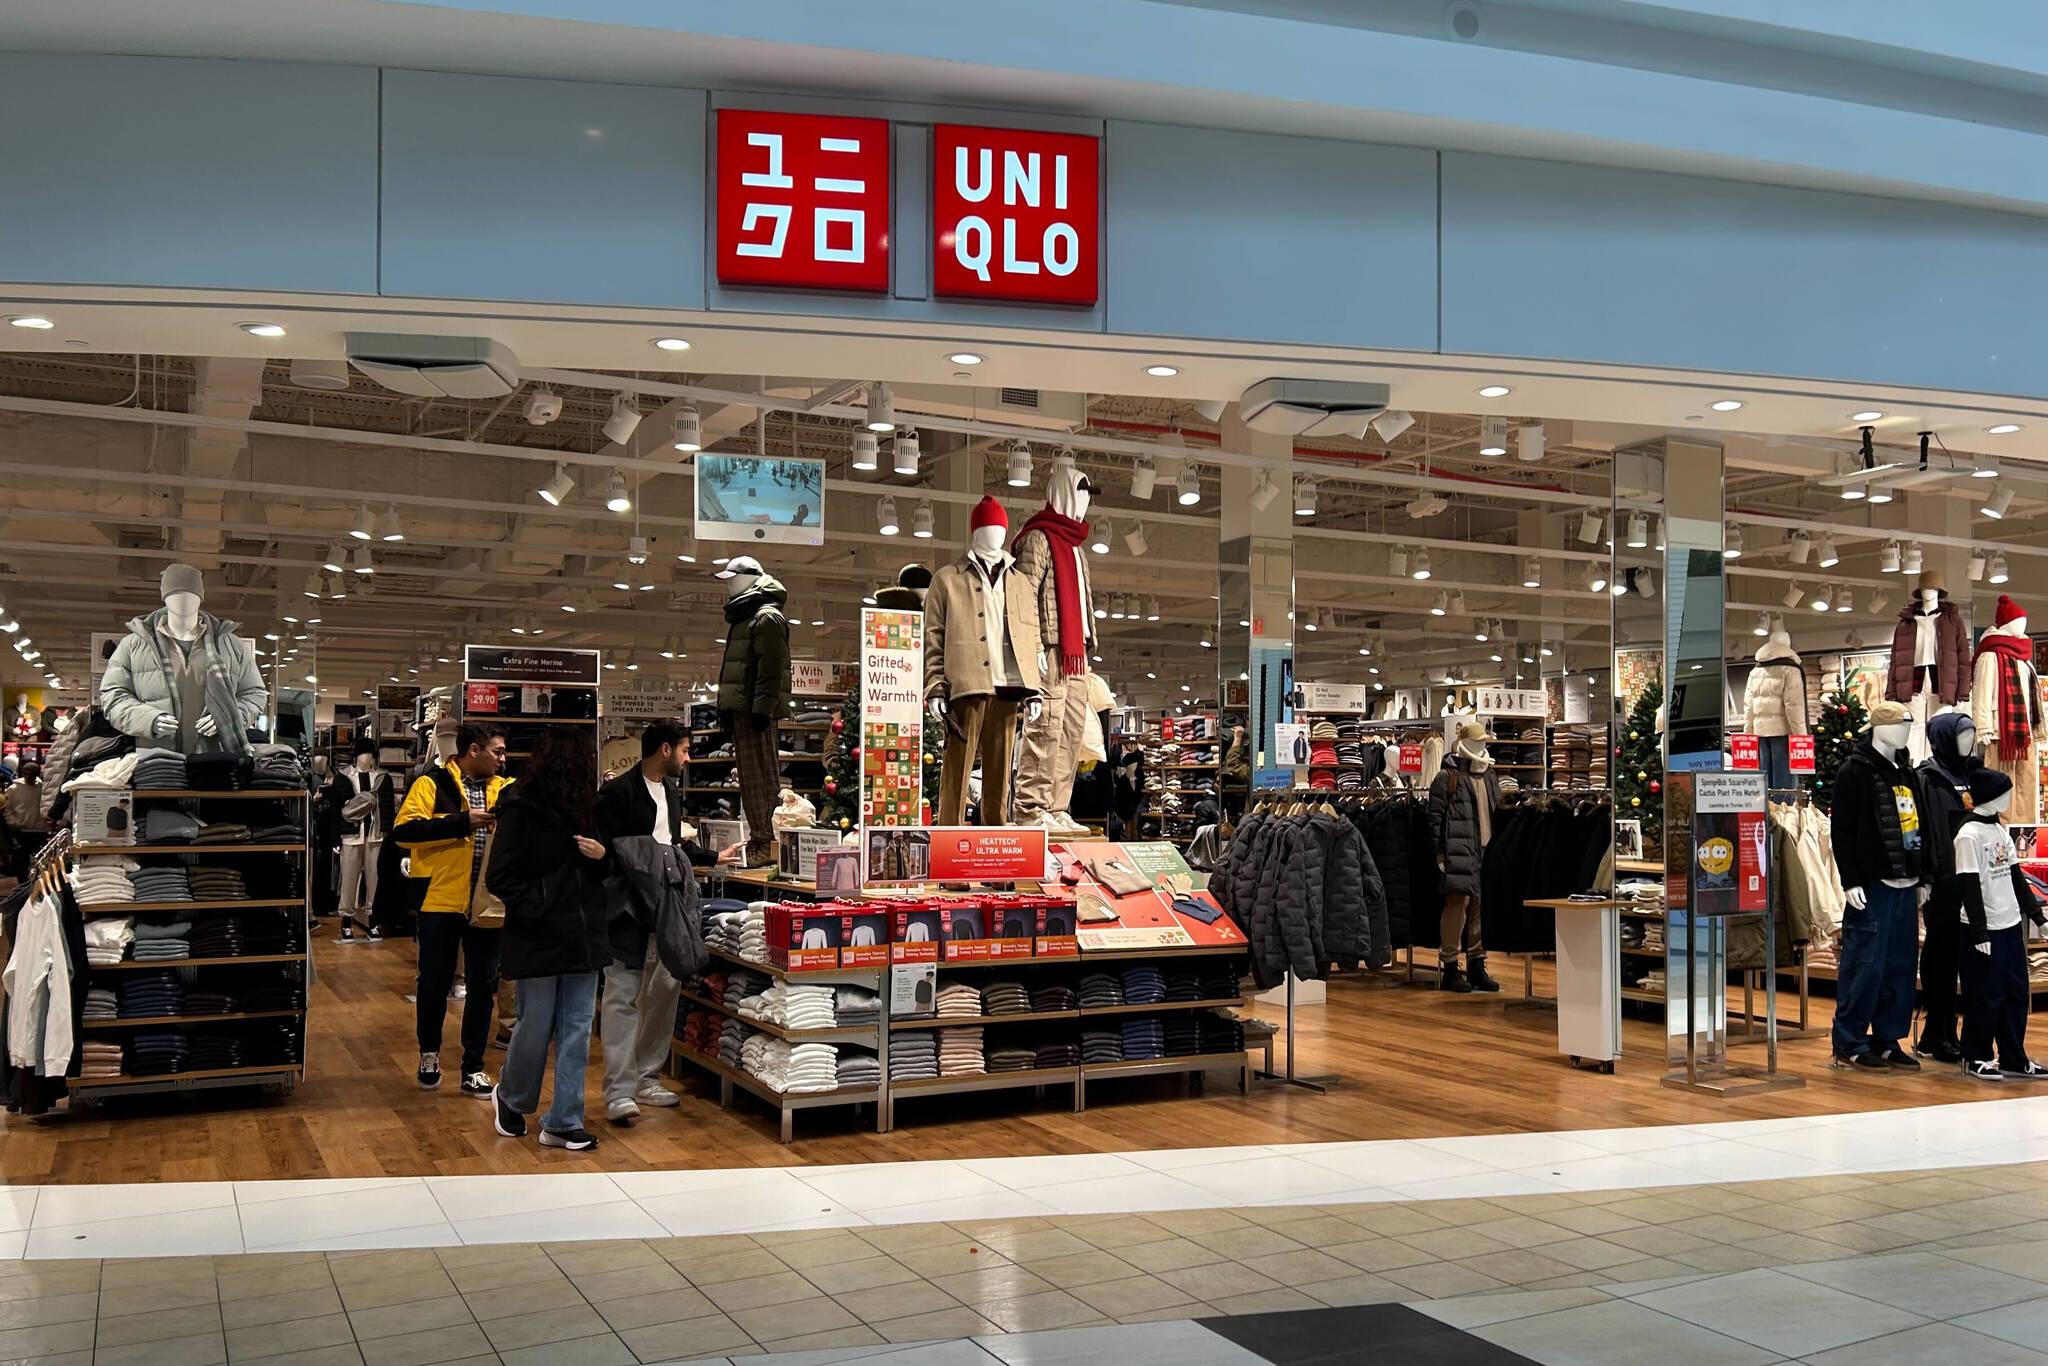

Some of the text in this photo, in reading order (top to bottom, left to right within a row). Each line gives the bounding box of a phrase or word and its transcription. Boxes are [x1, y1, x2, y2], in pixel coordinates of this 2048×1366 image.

[742, 132, 865, 193] ユニ
[955, 146, 1068, 210] UNI
[736, 203, 865, 264] クロ
[955, 215, 1079, 282] QLO
[503, 656, 522, 665] Extra
[524, 658, 538, 666] Fine
[868, 654, 904, 668] Gifted
[800, 665, 823, 676] With
[868, 672, 898, 685] With
[868, 688, 918, 702] Warmth
[1701, 778, 1758, 787] SpongeBob SquarePants
